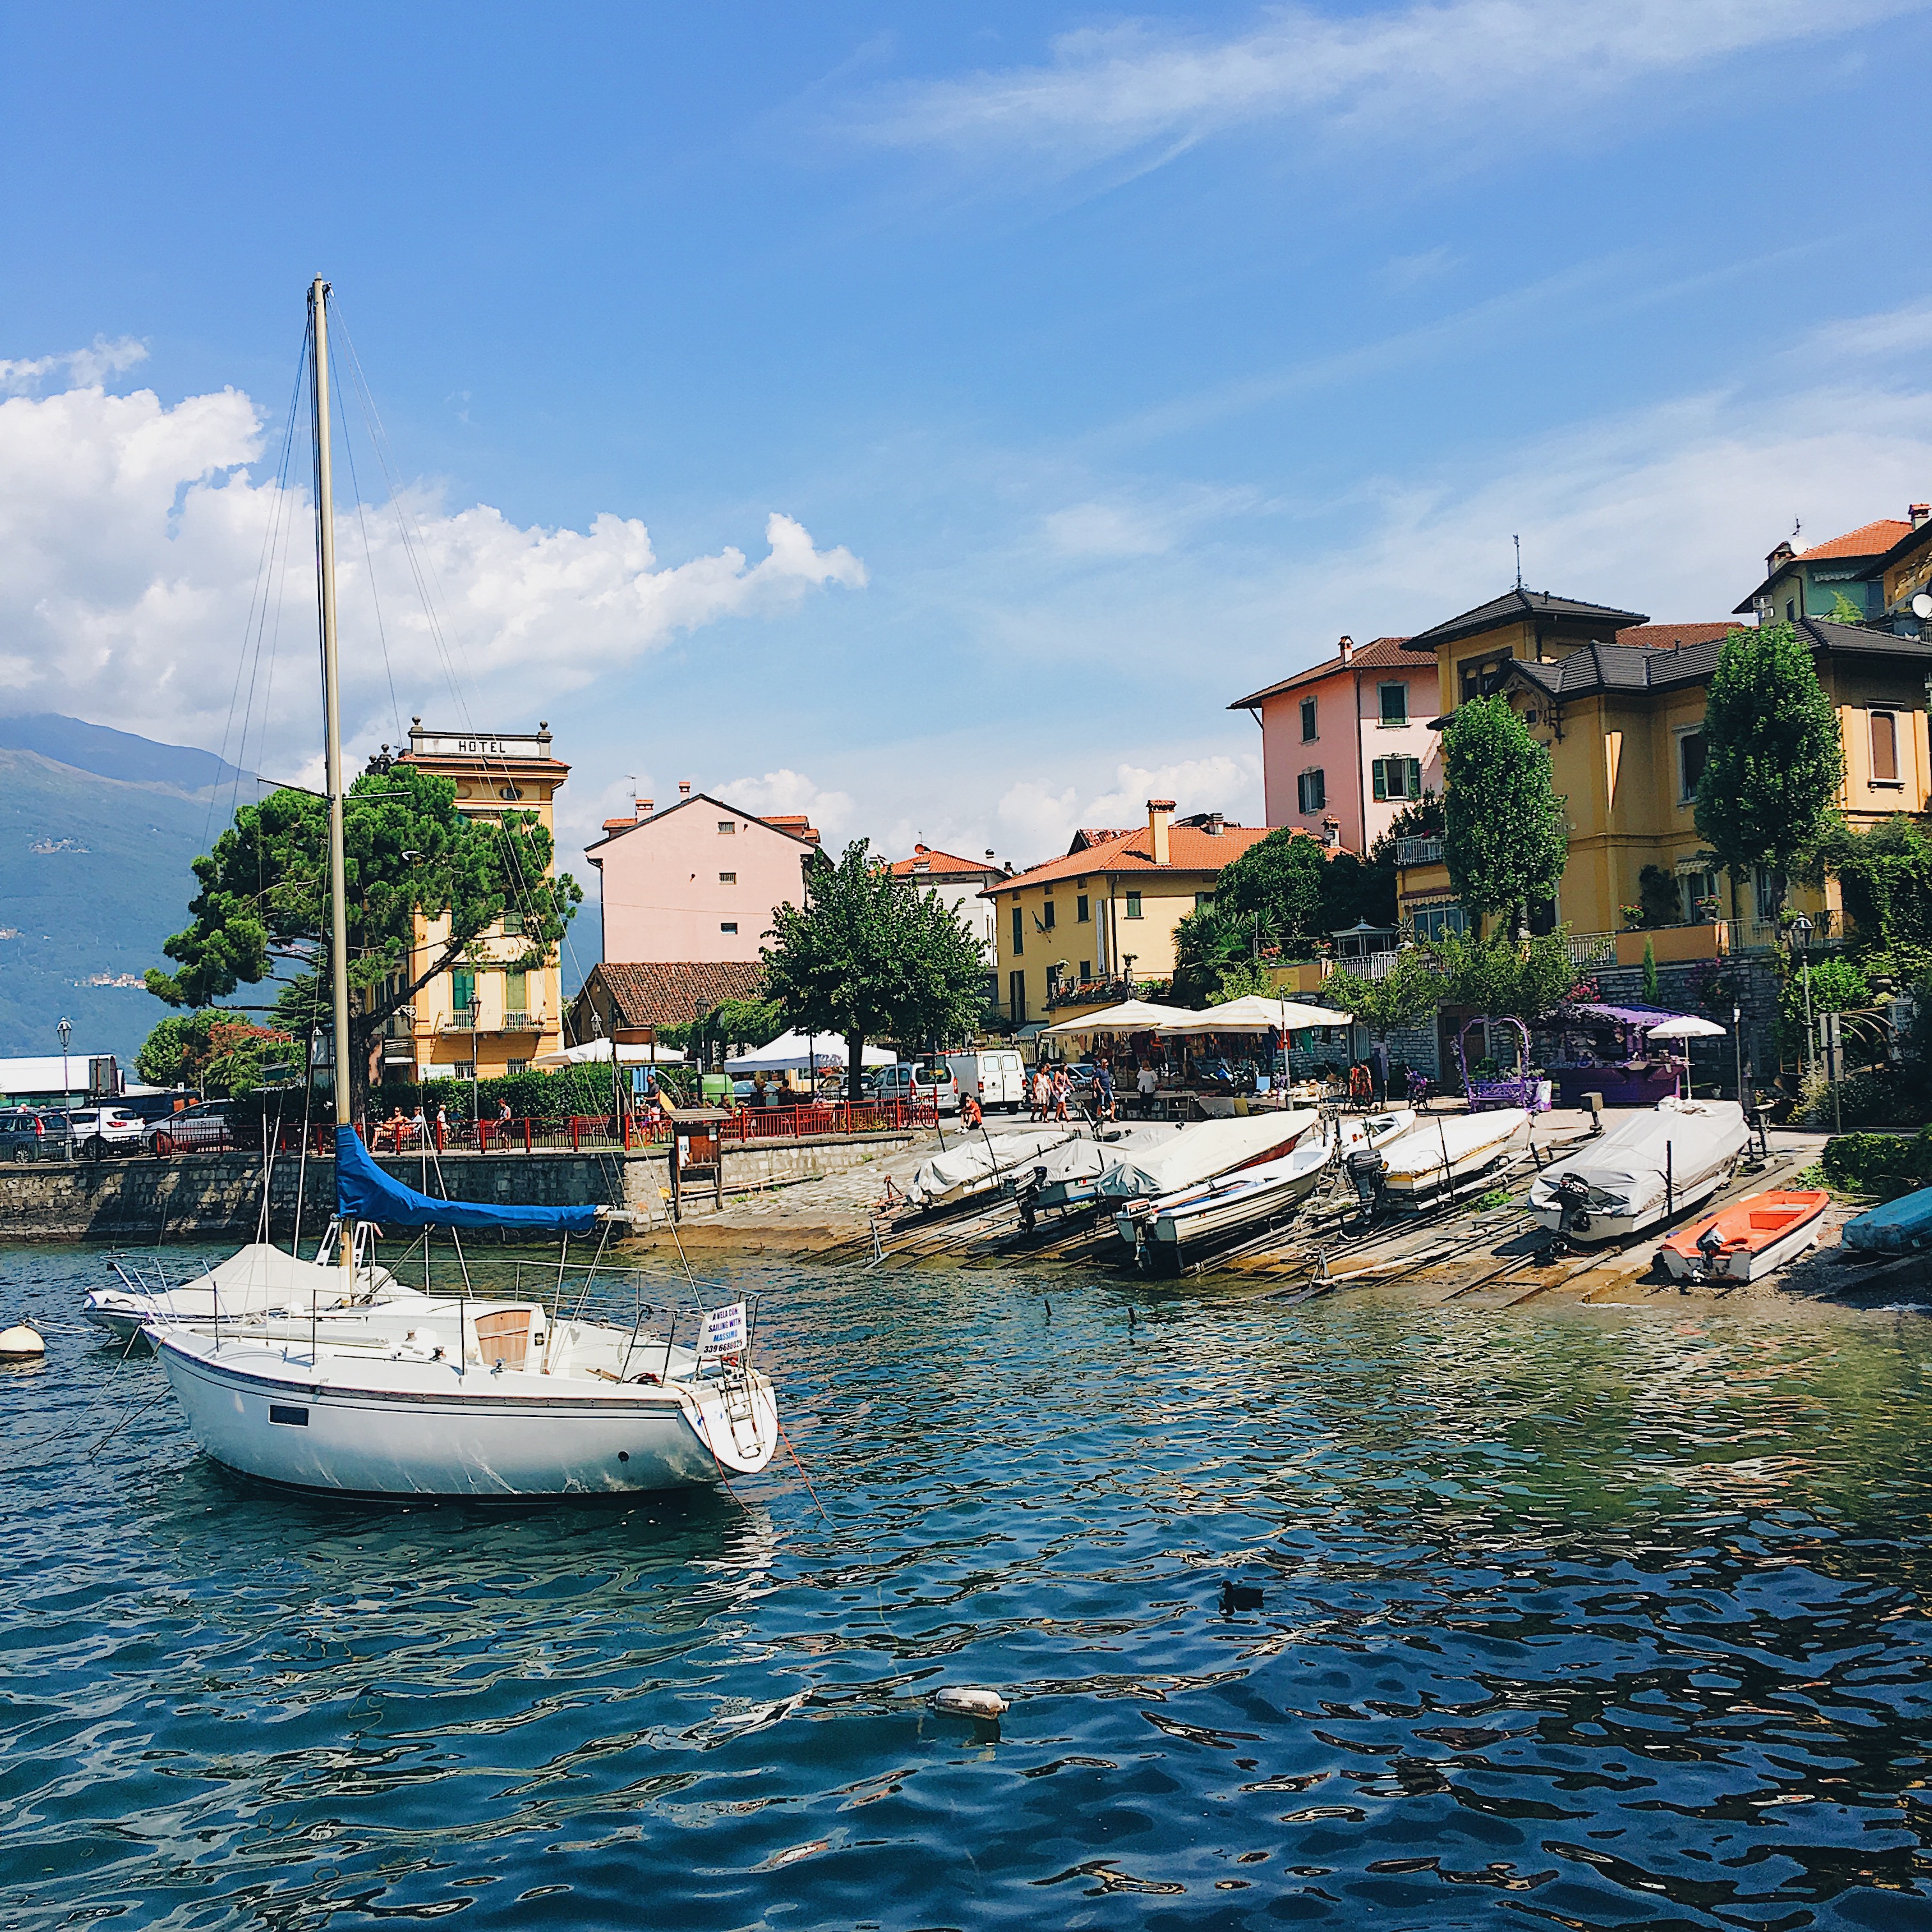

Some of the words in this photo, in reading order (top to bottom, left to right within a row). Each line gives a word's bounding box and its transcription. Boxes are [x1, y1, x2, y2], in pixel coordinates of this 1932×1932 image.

[459, 740, 506, 753] HOTEL
[717, 1310, 728, 1319] VELA
[709, 1321, 728, 1332] SAILING
[713, 1330, 738, 1342] MASSIMO
